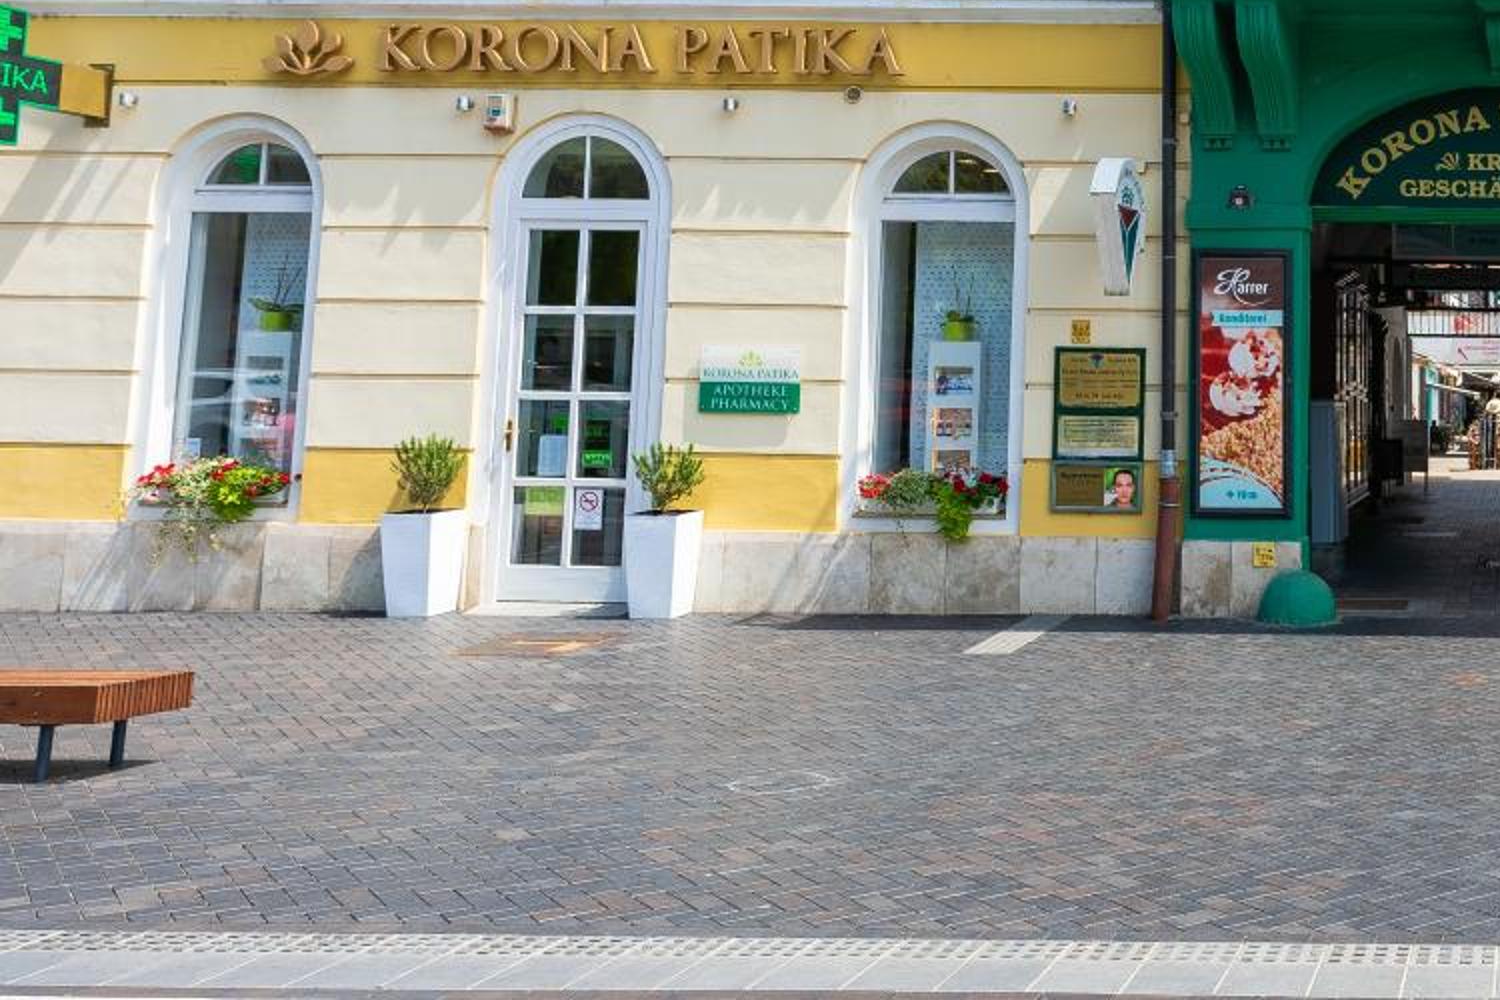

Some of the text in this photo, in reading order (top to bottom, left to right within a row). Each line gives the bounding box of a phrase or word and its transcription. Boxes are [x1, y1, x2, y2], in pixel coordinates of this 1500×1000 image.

[379, 24, 905, 77] KORONA PATIKA
[0, 62, 48, 95] IKA
[1335, 104, 1491, 200] KORONA
[1213, 267, 1271, 303] Harrer
[703, 367, 800, 379] KORONA PATIKA
[711, 397, 788, 410] PHARMACY
[713, 384, 786, 397] APOTHEKE
